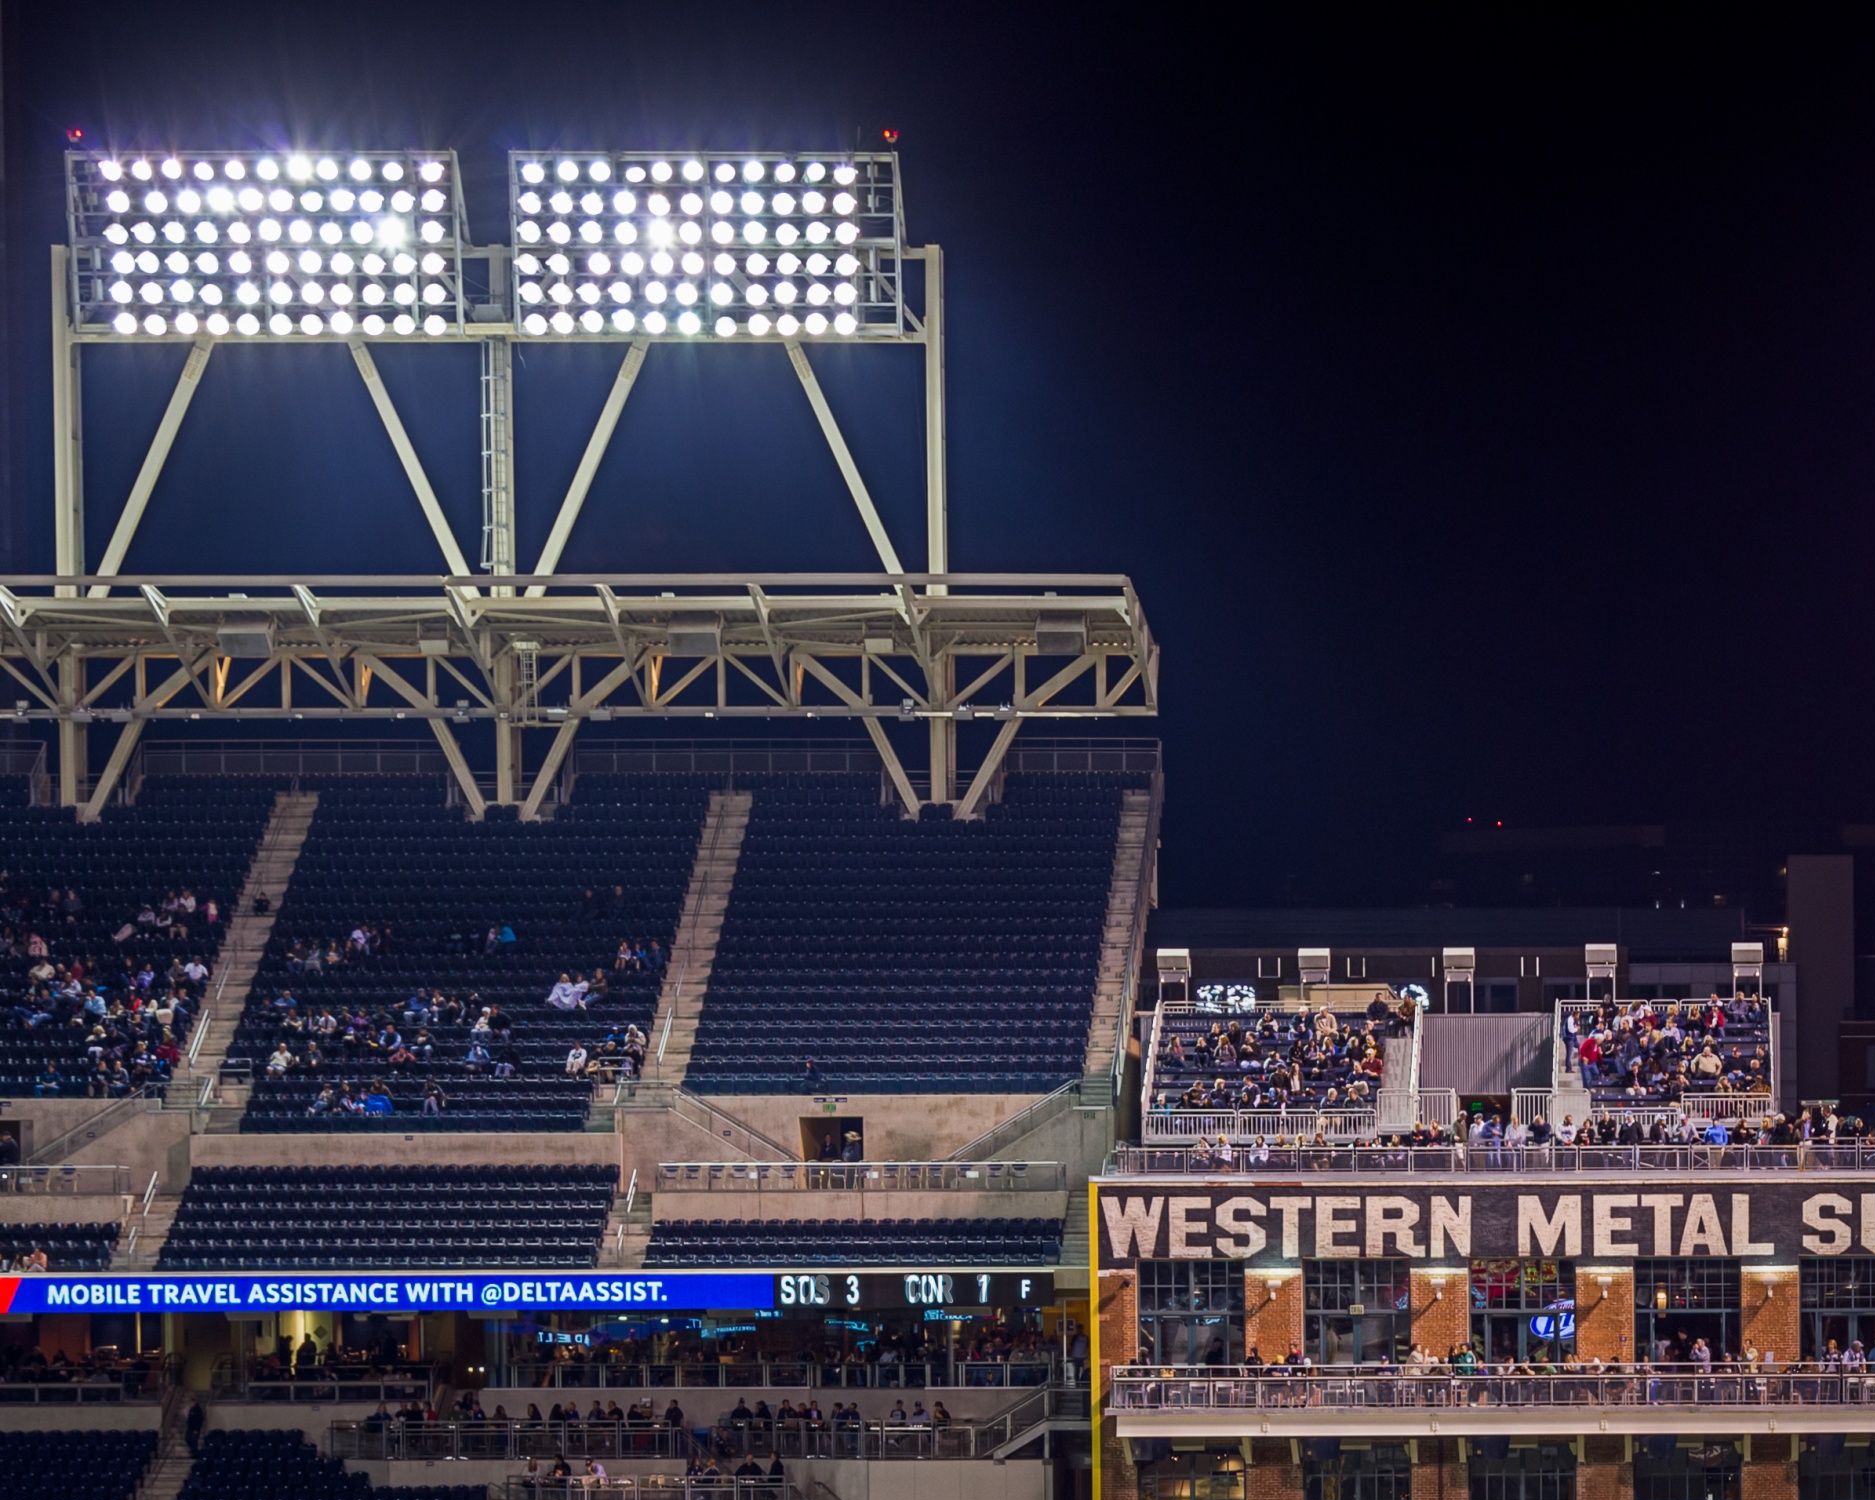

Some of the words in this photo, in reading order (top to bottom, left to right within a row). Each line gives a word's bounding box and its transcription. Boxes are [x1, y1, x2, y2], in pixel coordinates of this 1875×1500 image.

[1101, 1196, 1472, 1259] WESTERN
[1517, 1193, 1775, 1257] METAL
[47, 1284, 140, 1305] MOBILE
[148, 1284, 241, 1304] TRAVEL
[248, 1283, 398, 1303] ASSISTANCE
[405, 1282, 474, 1302] WITH
[480, 1281, 667, 1304] @DELTAASSIST.
